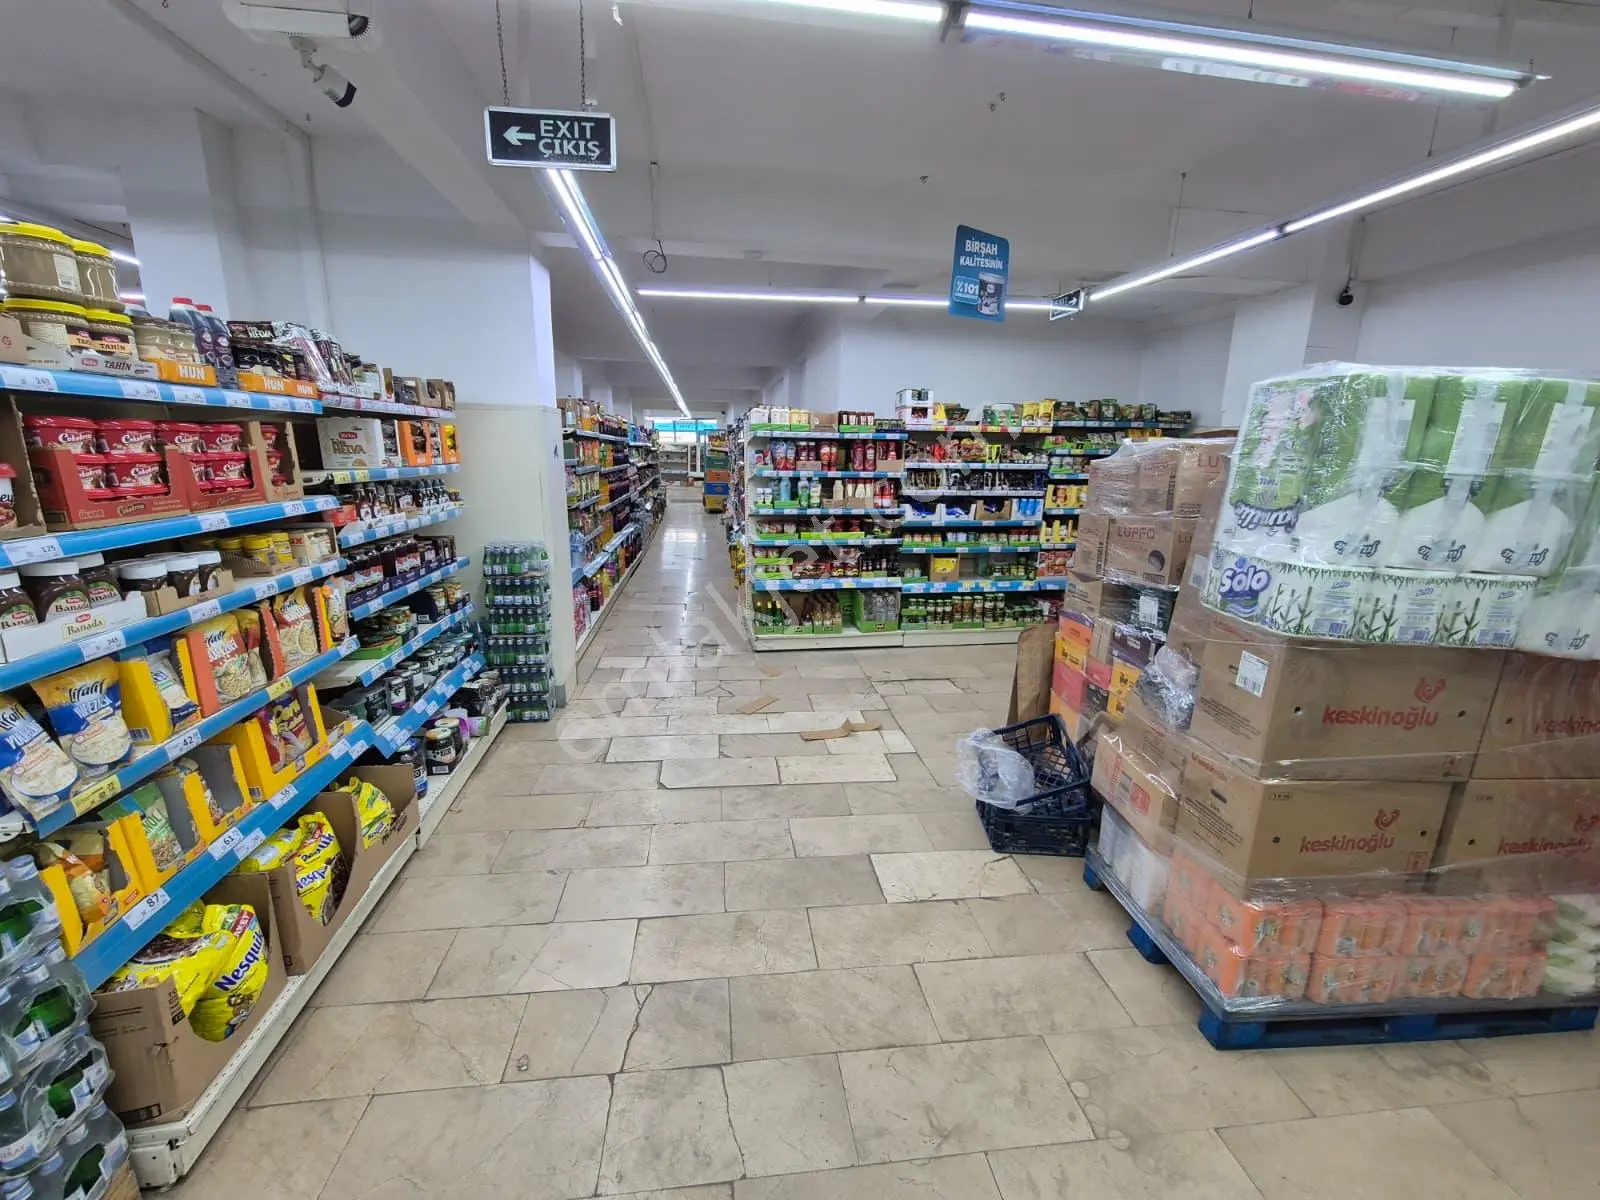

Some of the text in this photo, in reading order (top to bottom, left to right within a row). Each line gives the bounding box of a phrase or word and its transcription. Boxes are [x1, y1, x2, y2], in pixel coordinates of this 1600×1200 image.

[539, 119, 596, 139] EXIT
[538, 139, 600, 160] ÇIKIŞ
[965, 237, 998, 257] BİRŞAH
[959, 254, 1003, 269] KALİTESİNİN
[104, 359, 132, 371] TAHİN
[1322, 704, 1439, 730] keskinoğlu
[183, 736, 193, 747] 42
[223, 835, 234, 845] 61
[1299, 833, 1396, 854] keskinoğlu
[146, 893, 159, 907] 87
[214, 930, 265, 992] Nesquik
